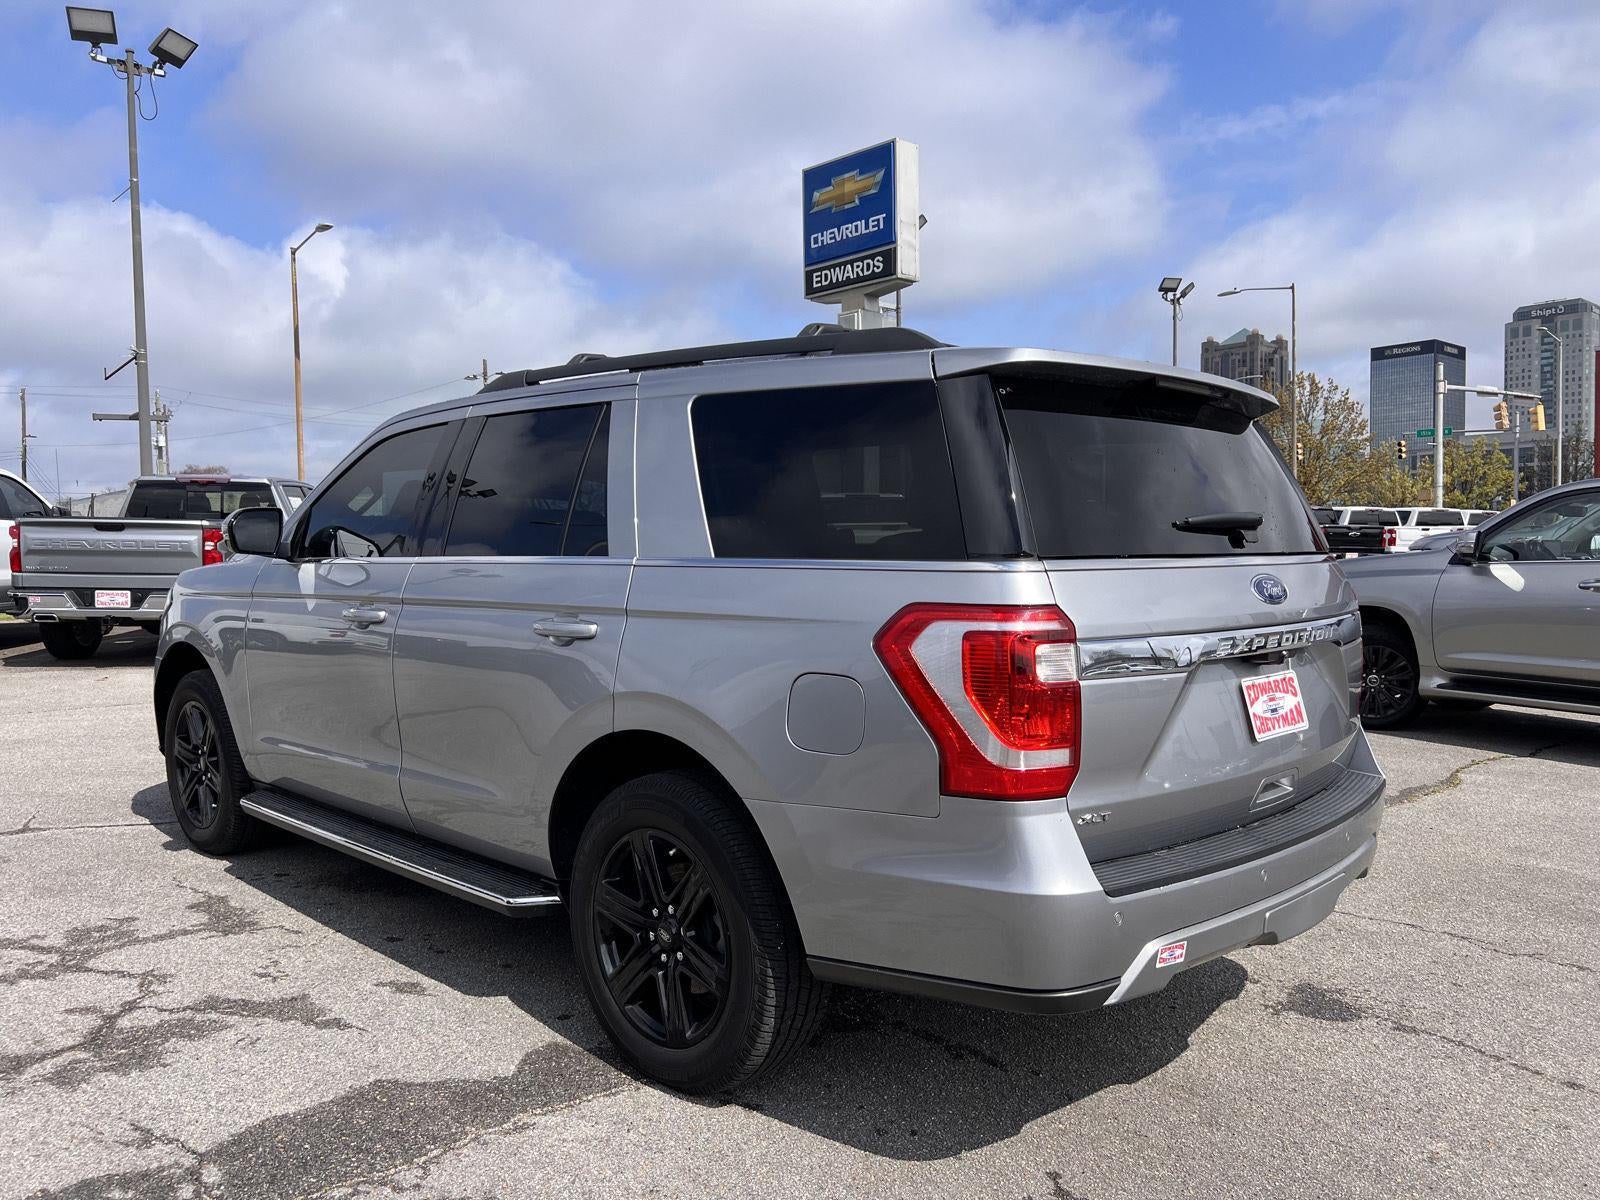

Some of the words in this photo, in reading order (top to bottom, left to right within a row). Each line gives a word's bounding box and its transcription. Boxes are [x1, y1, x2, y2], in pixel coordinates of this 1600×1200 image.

[810, 213, 886, 248] CHEVROLET
[812, 256, 884, 288] EDWARDS
[31, 539, 188, 550] CHEVROLET
[1262, 580, 1283, 597] Ford
[1216, 626, 1335, 656] EXPEDITION
[1245, 676, 1298, 709] EDWARDS
[1252, 700, 1305, 735] CHEVYMAN
